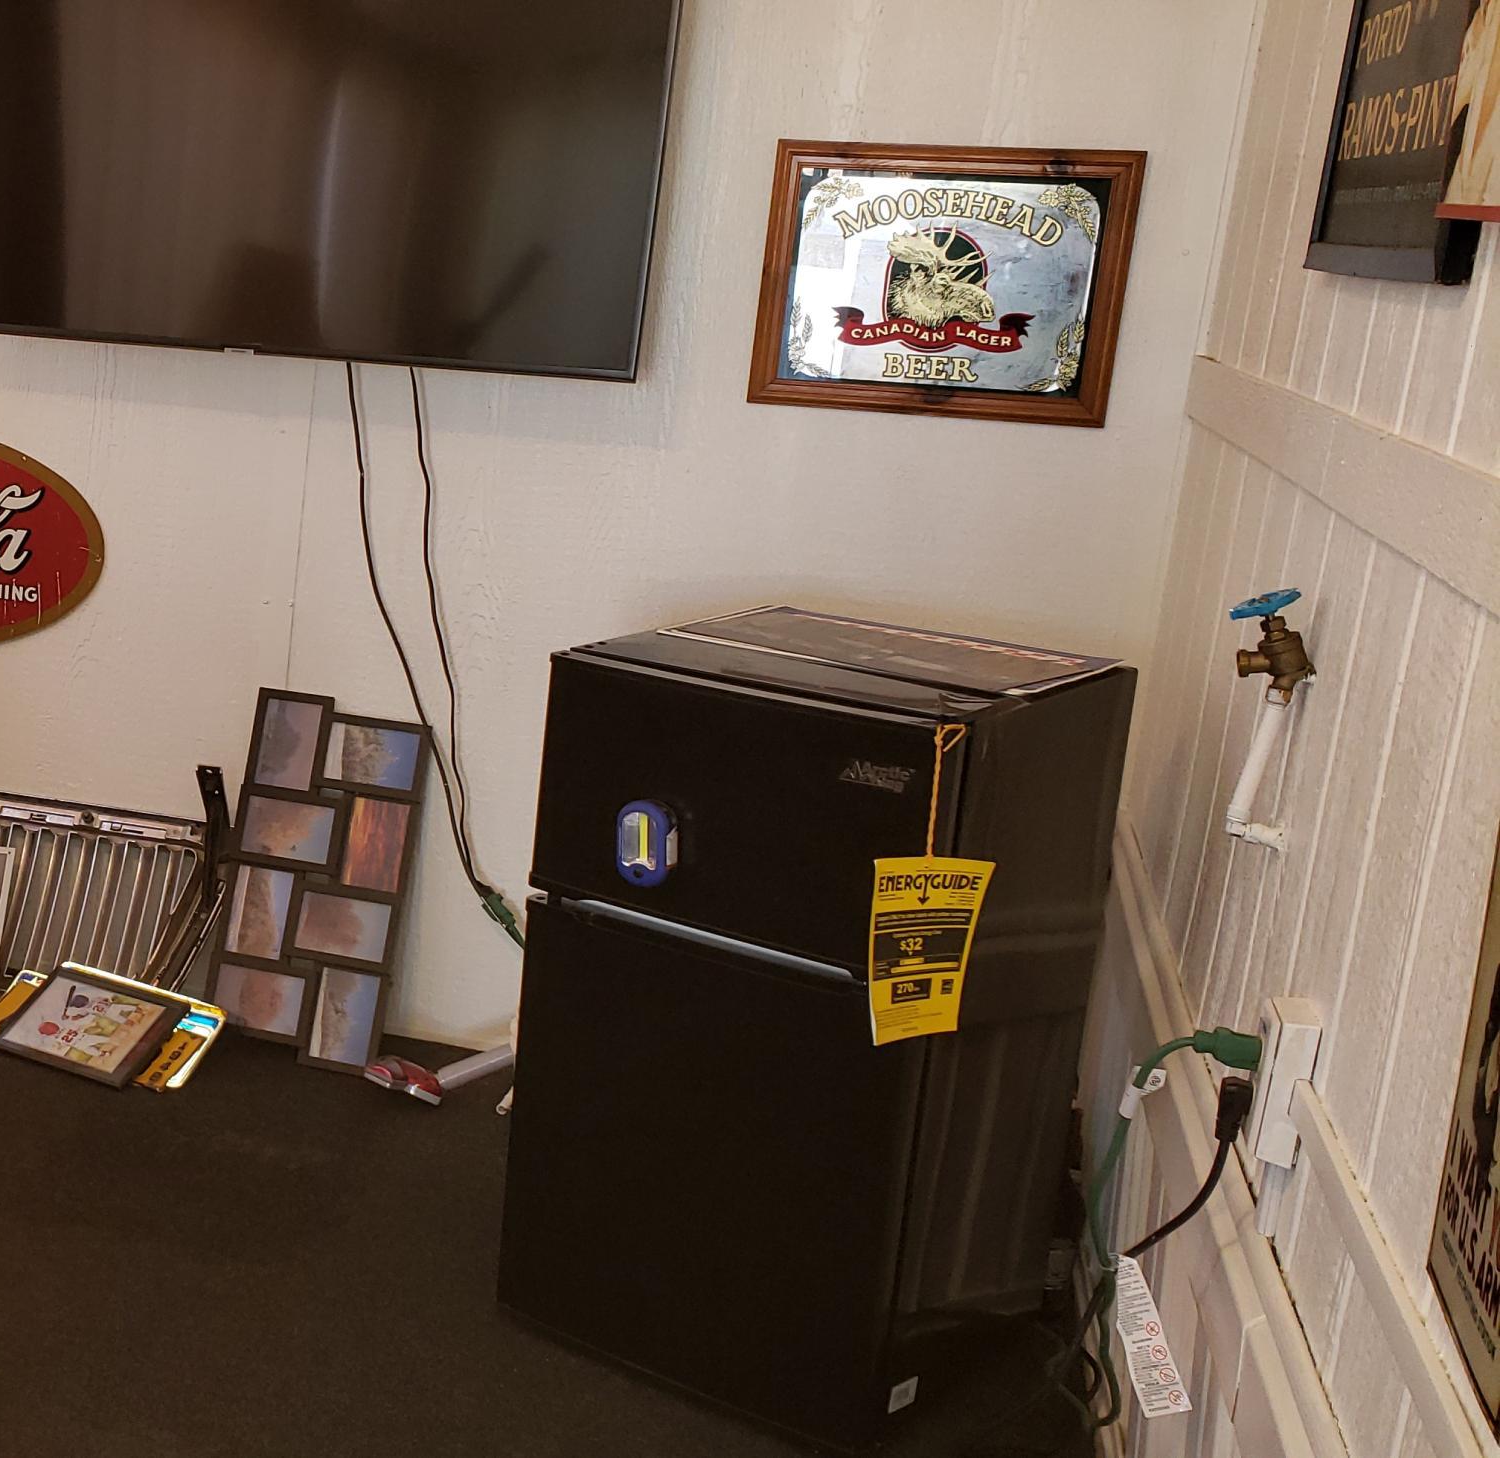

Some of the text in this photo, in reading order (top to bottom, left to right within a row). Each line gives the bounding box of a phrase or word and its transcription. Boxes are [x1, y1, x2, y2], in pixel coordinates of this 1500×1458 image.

[1356, 1, 1411, 69] PORTO
[1338, 75, 1457, 161] RAMOS-PINT
[833, 189, 1064, 247] MOOSEHEAD
[851, 322, 1012, 347] CANADIAN LAGER
[882, 353, 979, 383] BEER
